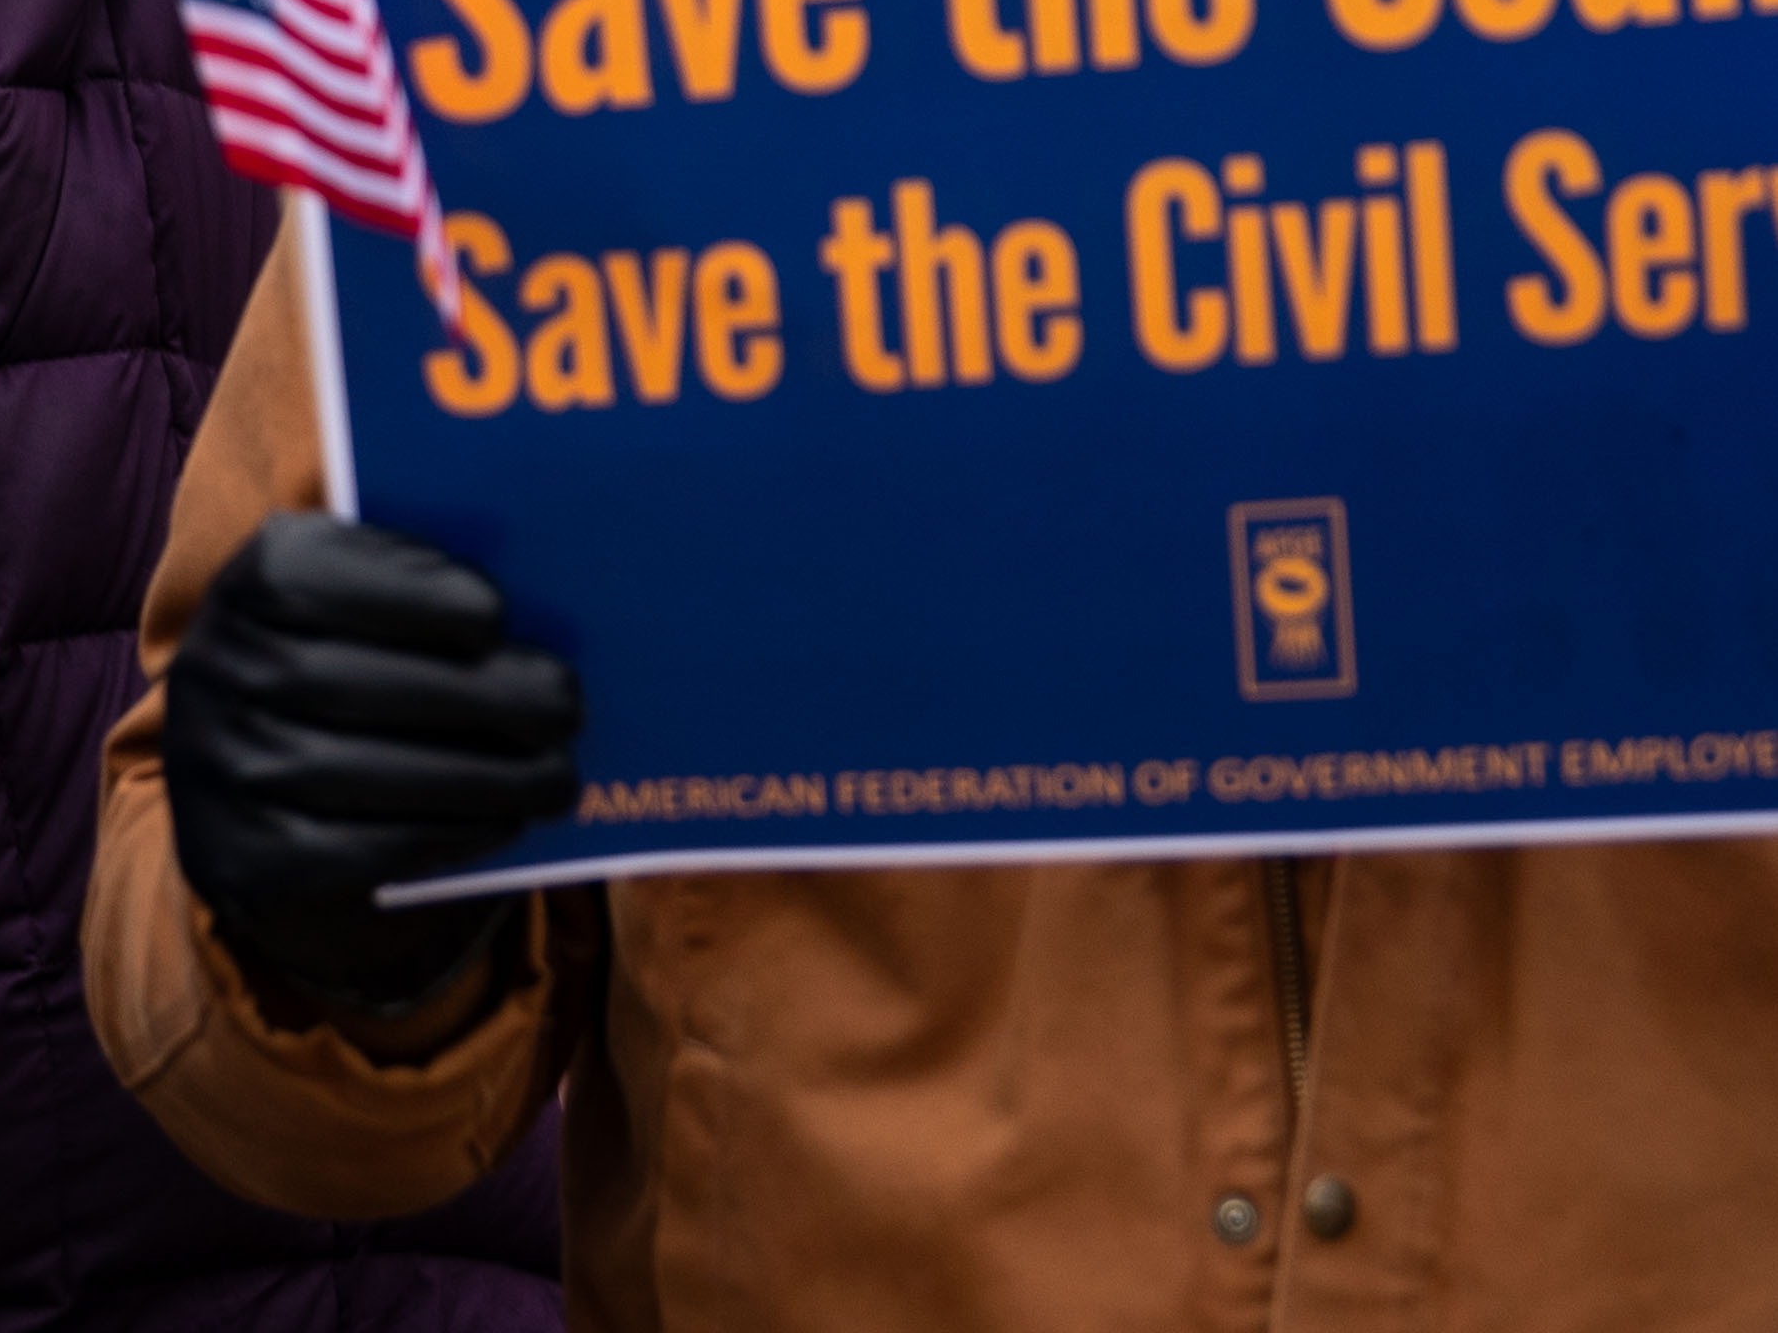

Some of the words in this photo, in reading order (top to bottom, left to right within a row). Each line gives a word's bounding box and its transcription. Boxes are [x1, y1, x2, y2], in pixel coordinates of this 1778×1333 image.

[419, 211, 783, 419] Save
[823, 182, 1080, 389] the
[1129, 144, 1454, 368] Civil
[1502, 129, 1778, 345] Ser
[579, 774, 826, 825] AMERICAN
[836, 764, 1123, 815] FEDERATION
[1135, 760, 1200, 804] OF
[1208, 741, 1549, 803] GOVERNMENT
